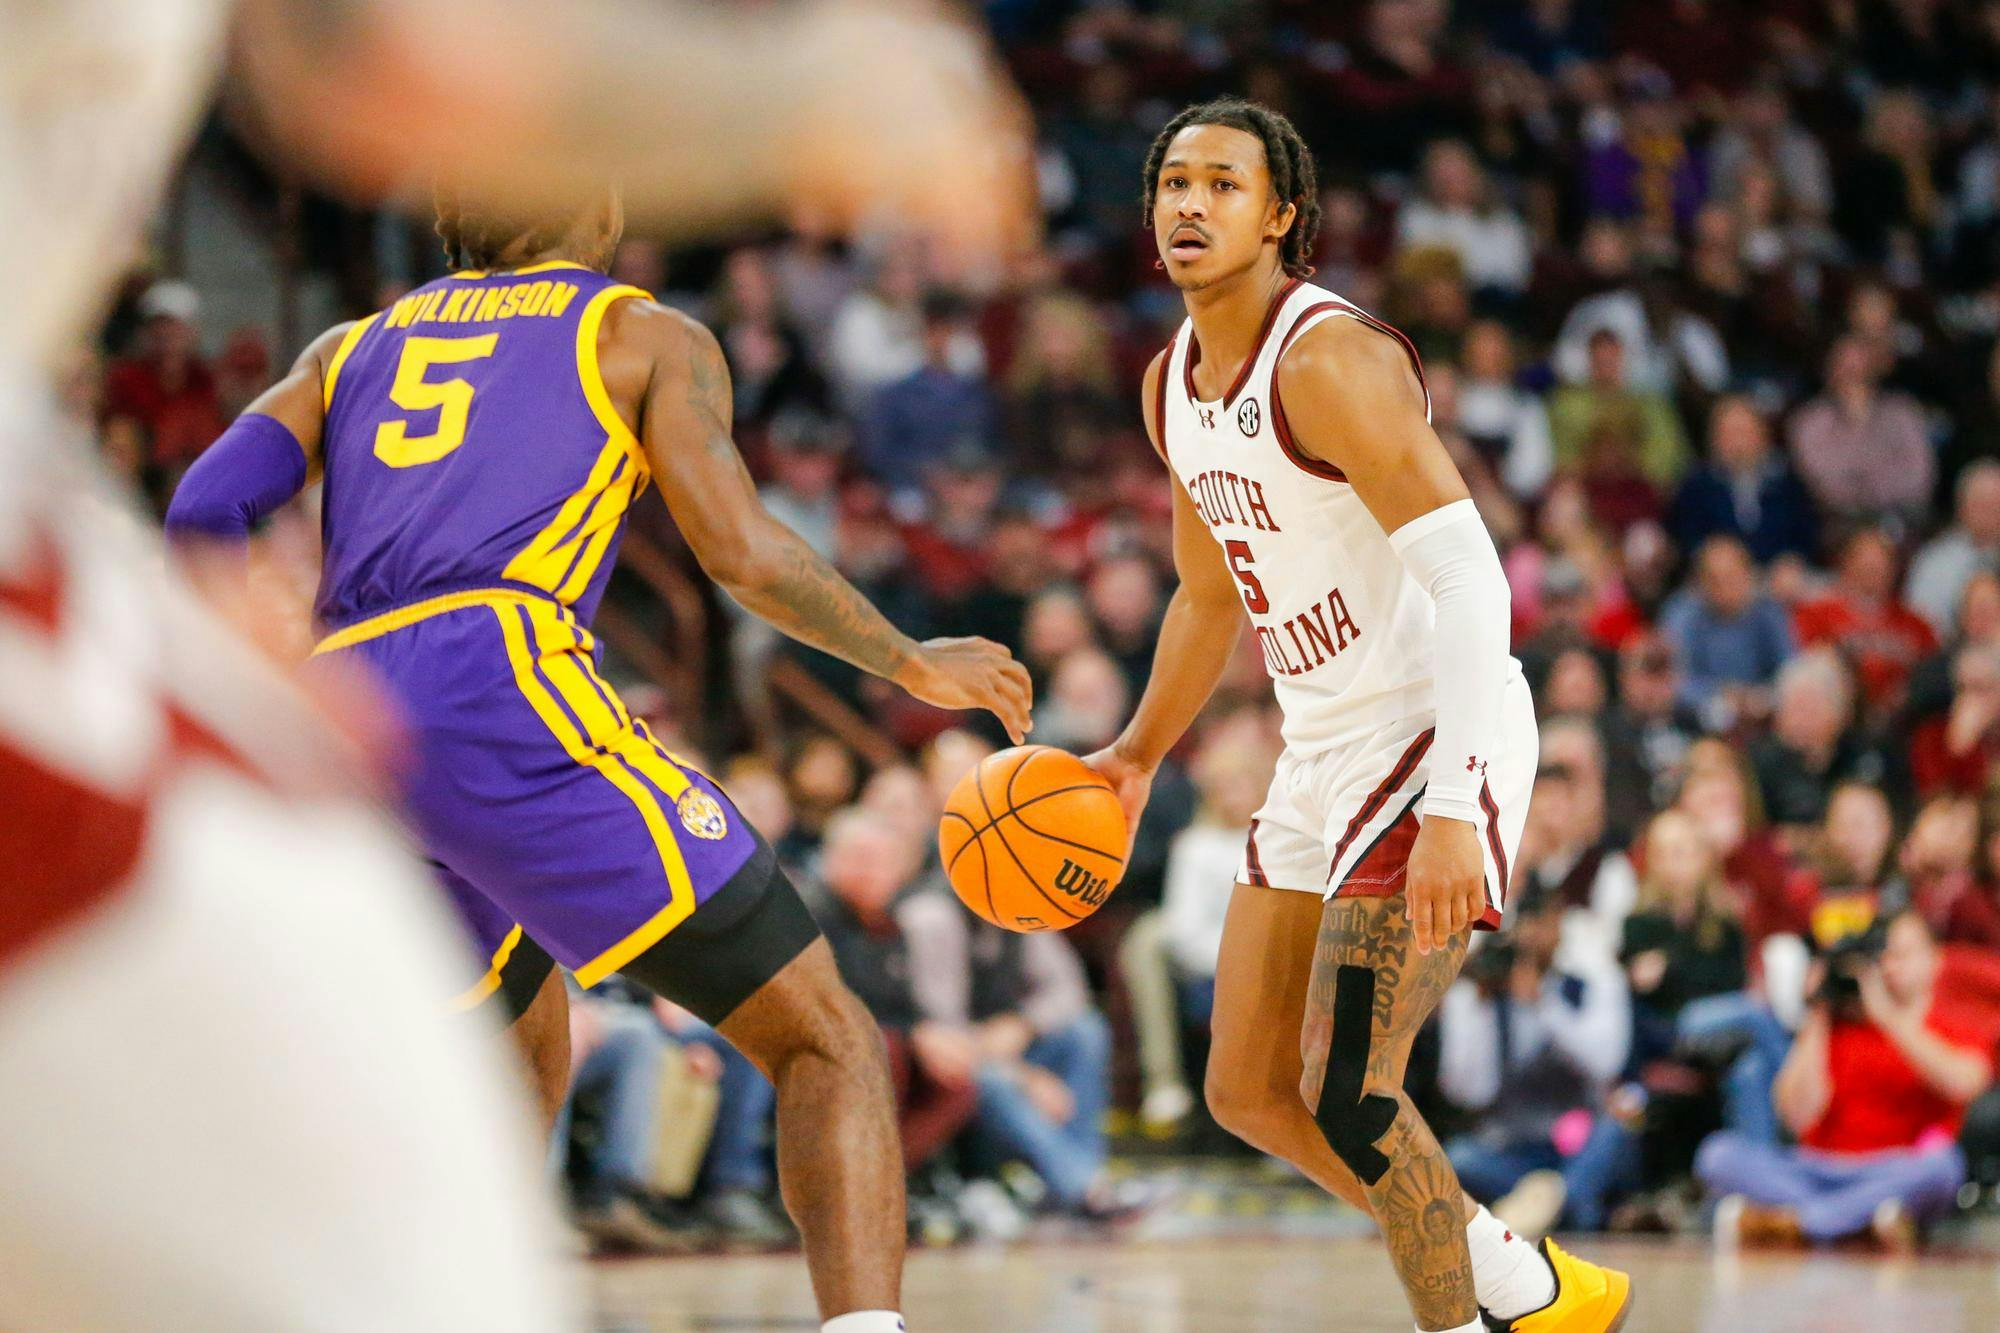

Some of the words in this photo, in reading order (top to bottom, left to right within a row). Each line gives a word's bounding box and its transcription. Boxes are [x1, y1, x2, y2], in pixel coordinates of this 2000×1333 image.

[384, 281, 579, 329] WILKINSON
[373, 333, 499, 469] 5
[1239, 399, 1259, 437] SEC
[1189, 470, 1281, 532] SOUTH
[1225, 539, 1270, 614] 5
[1256, 587, 1361, 676] OLINA
[1424, 1264, 1470, 1289] CHILD
